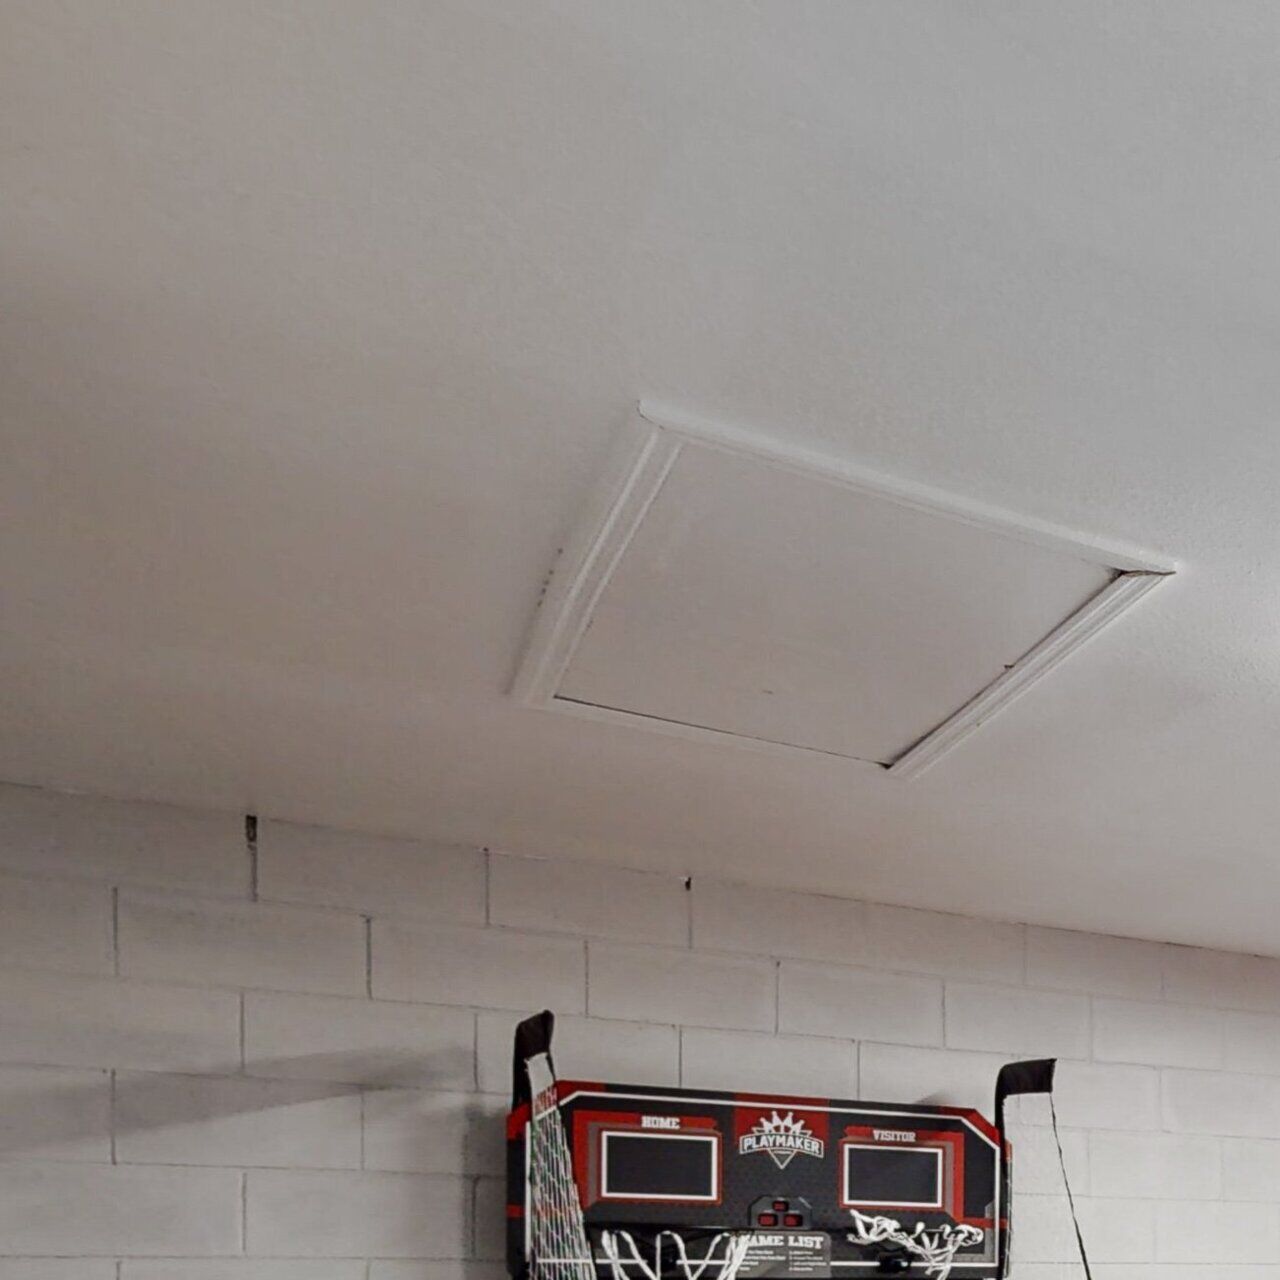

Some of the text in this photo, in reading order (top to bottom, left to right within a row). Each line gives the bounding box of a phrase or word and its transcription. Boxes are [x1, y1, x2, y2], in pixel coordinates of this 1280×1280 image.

[641, 1115, 681, 1130] HOME
[873, 1129, 916, 1142] VISITOR
[743, 1134, 820, 1154] PLAYMAKER
[744, 1235, 824, 1250] AME LIST
